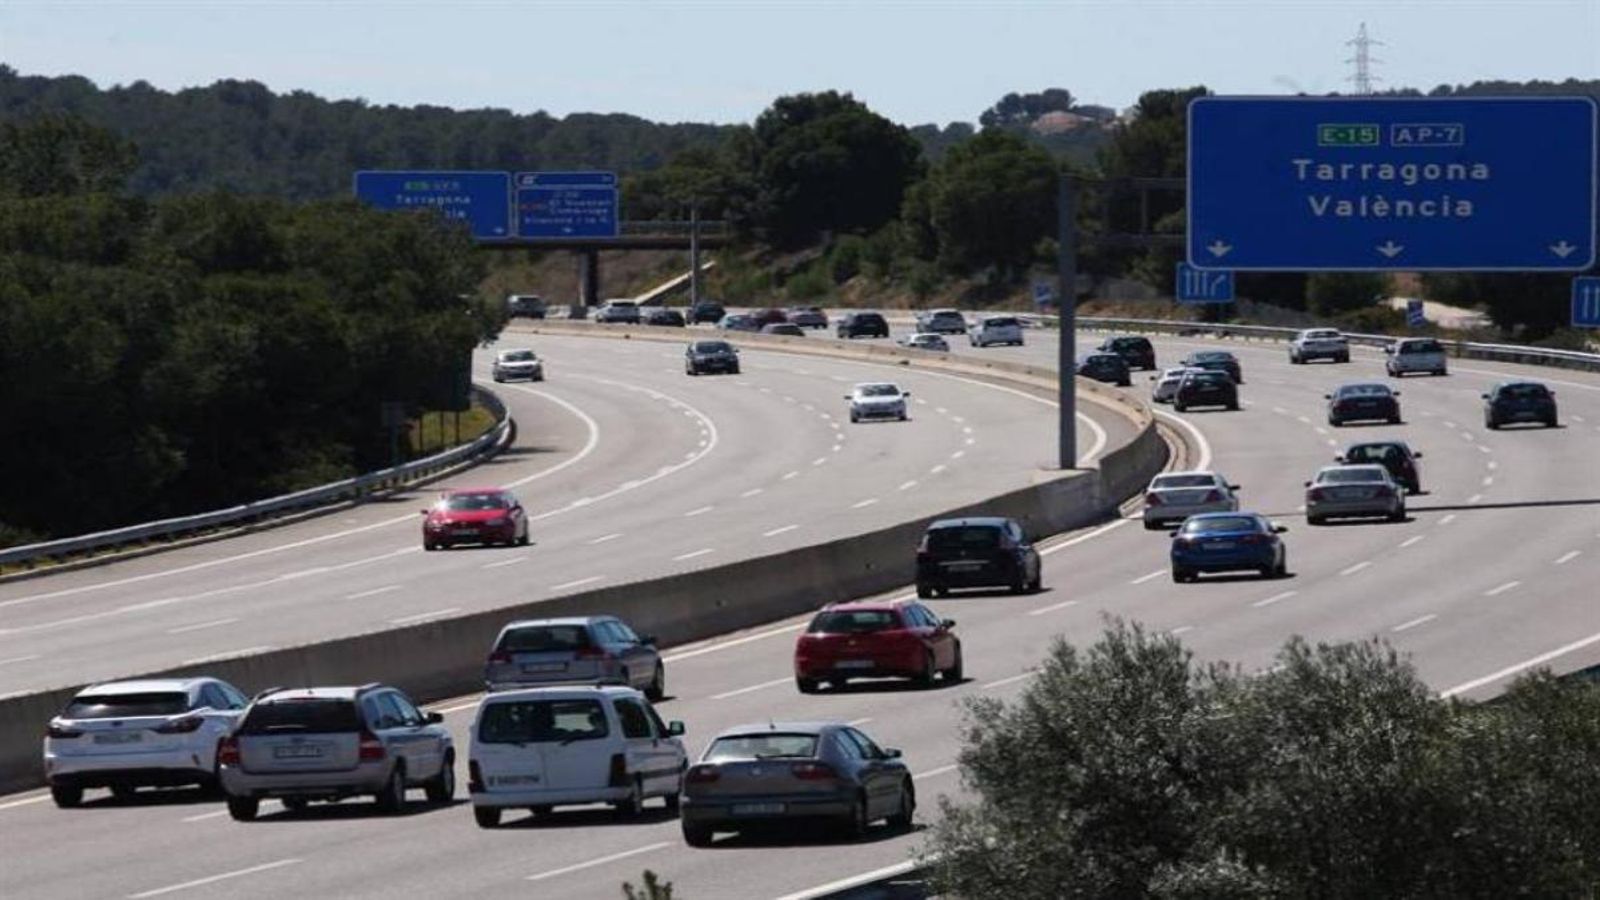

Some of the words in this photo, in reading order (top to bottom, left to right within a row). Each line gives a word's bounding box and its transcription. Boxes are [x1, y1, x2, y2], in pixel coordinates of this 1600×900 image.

[1322, 127, 1374, 142] E-15
[1396, 127, 1457, 142] AP-7
[1292, 158, 1489, 186] Tarragona
[1308, 195, 1473, 217] València
